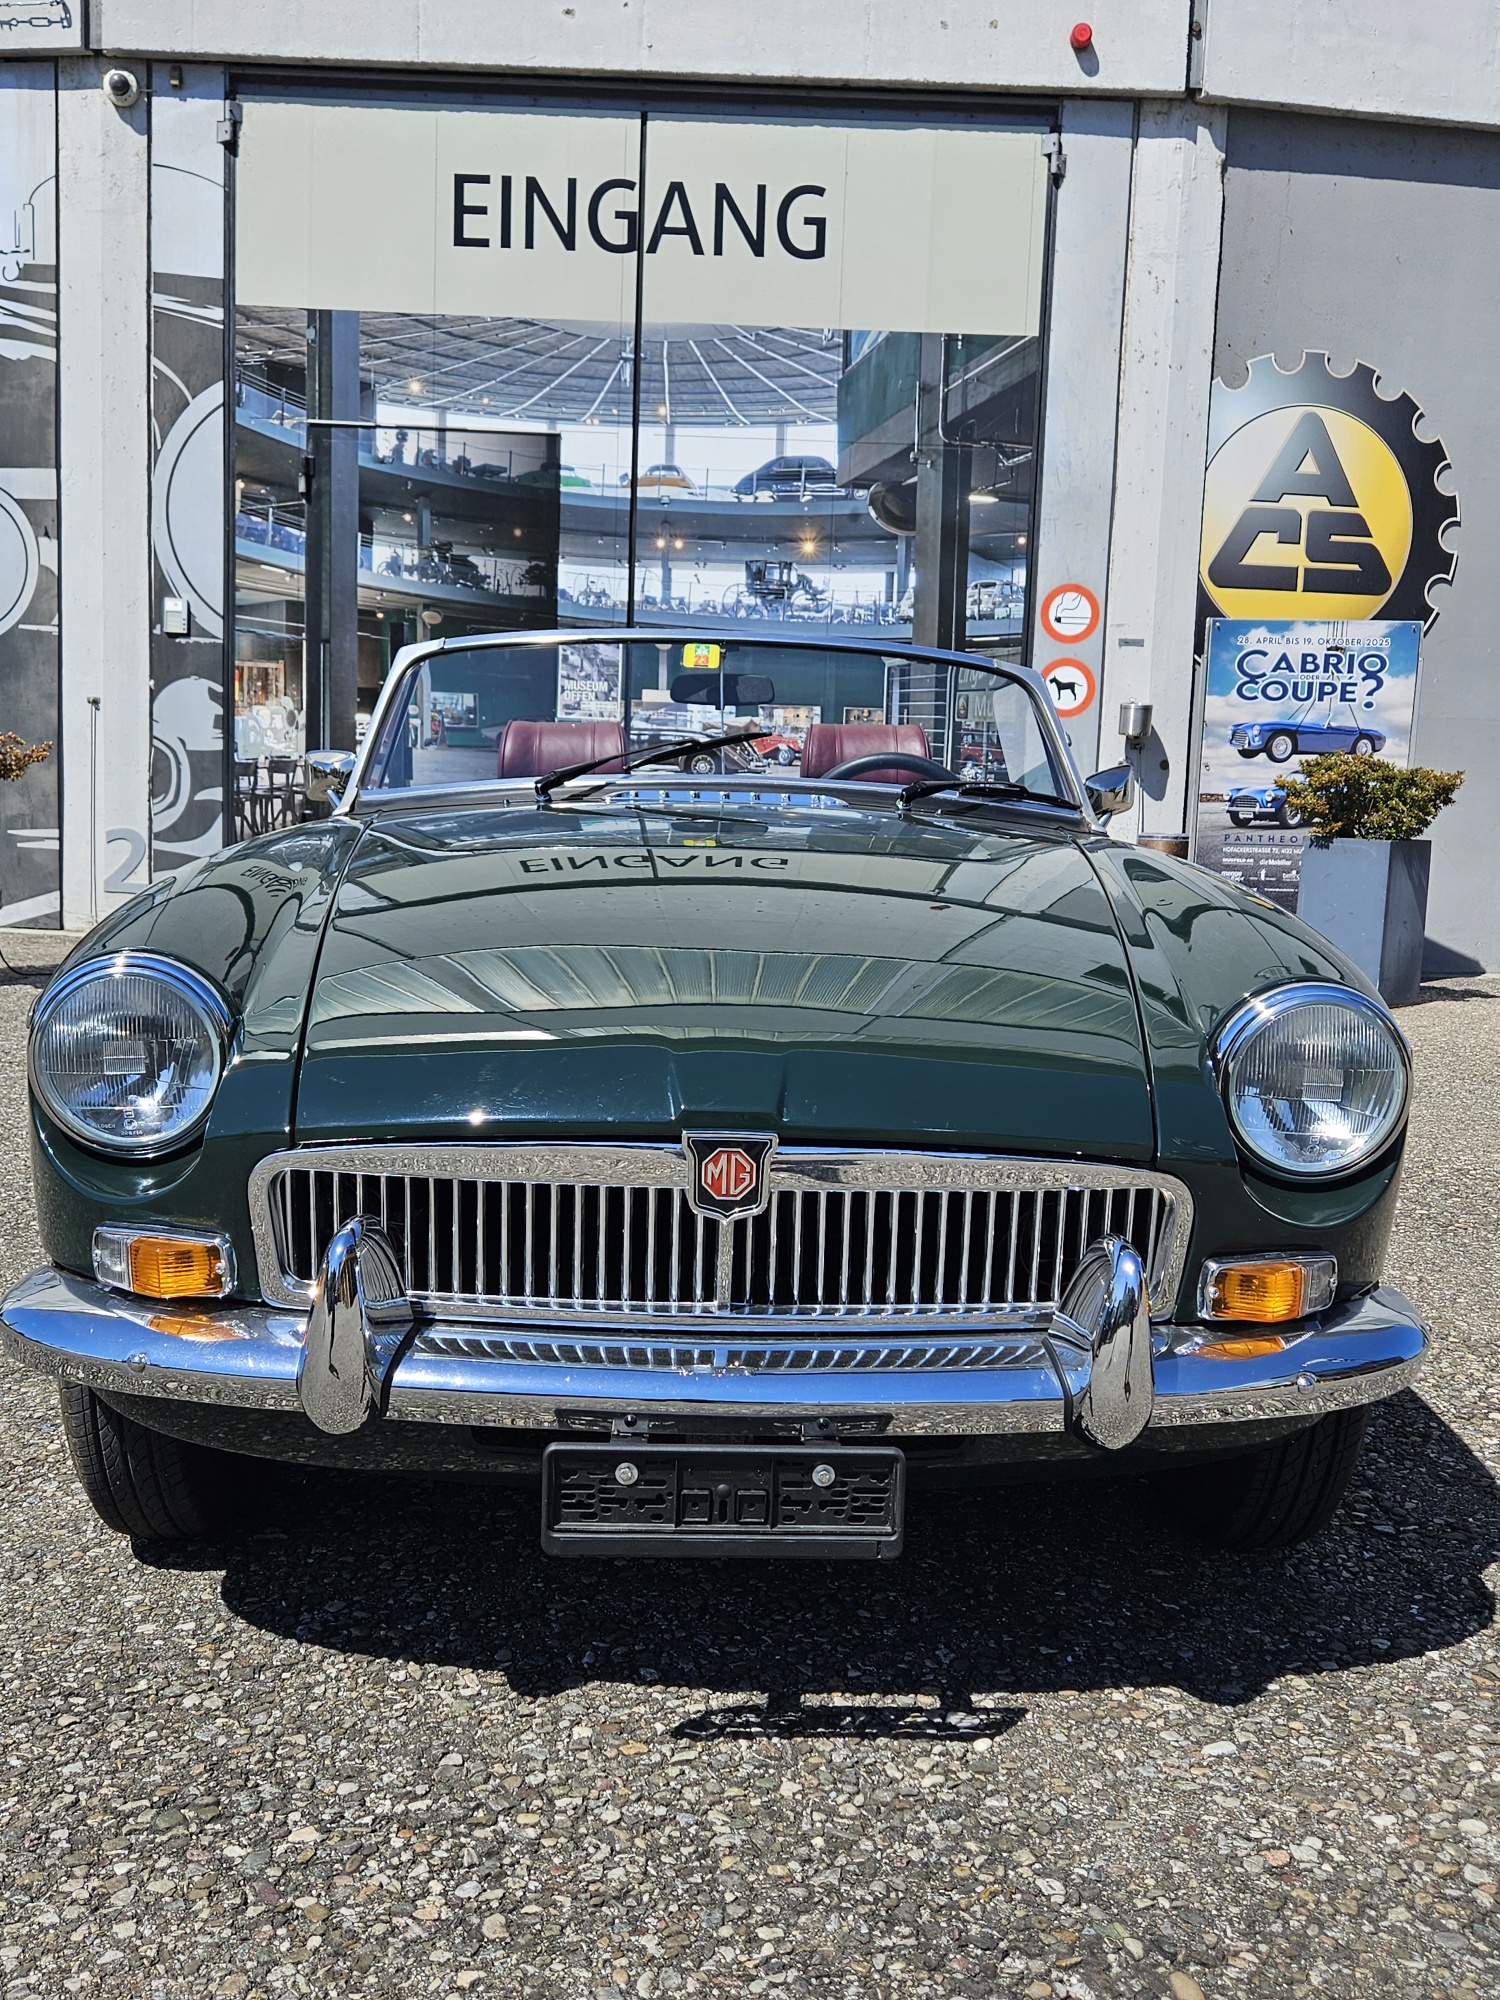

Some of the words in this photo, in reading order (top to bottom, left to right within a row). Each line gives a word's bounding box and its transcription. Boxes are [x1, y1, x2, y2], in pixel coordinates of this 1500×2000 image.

[453, 173, 827, 260] EINGANG
[1237, 636, 1252, 645] 28.
[1256, 637, 1282, 645] APRIL
[1286, 637, 1300, 645] BIS
[1303, 637, 1314, 646] 19.
[1318, 637, 1362, 646] OKTOBER
[1365, 637, 1390, 646] 2025
[694, 655, 709, 666] 23
[1236, 649, 1388, 680] CABRIO
[564, 680, 608, 692] MUSEUM
[564, 690, 595, 701] OFFEN
[1224, 834, 1298, 843] PANTHEO
[104, 827, 148, 894] 2
[707, 1153, 751, 1195] MG
